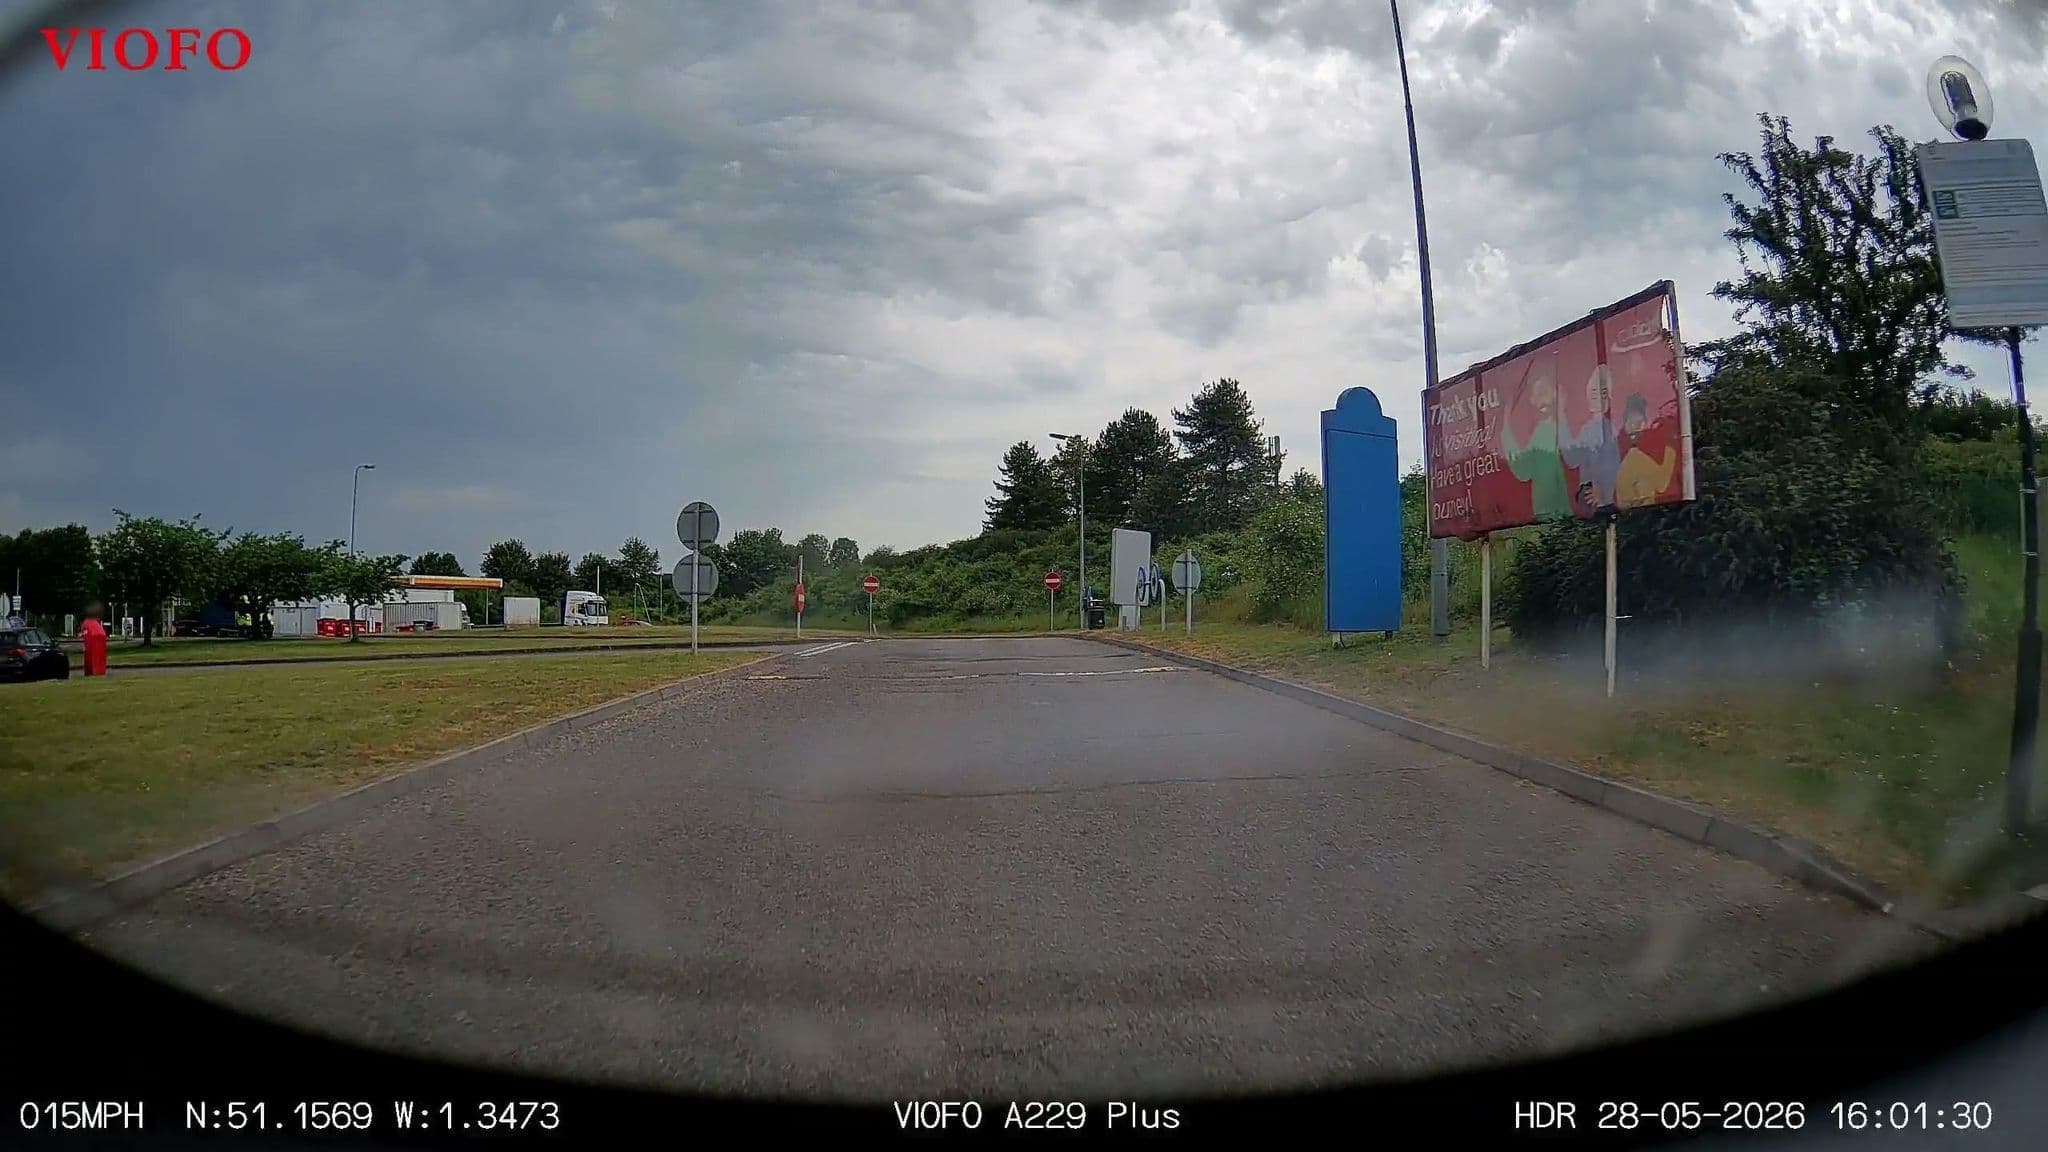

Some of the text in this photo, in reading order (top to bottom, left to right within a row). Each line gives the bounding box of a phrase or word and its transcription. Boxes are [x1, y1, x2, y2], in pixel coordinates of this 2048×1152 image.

[1466, 388, 1500, 420] you
[1455, 464, 1462, 482] a
[1463, 452, 1501, 486] great
[1433, 488, 1475, 522] ourney!
